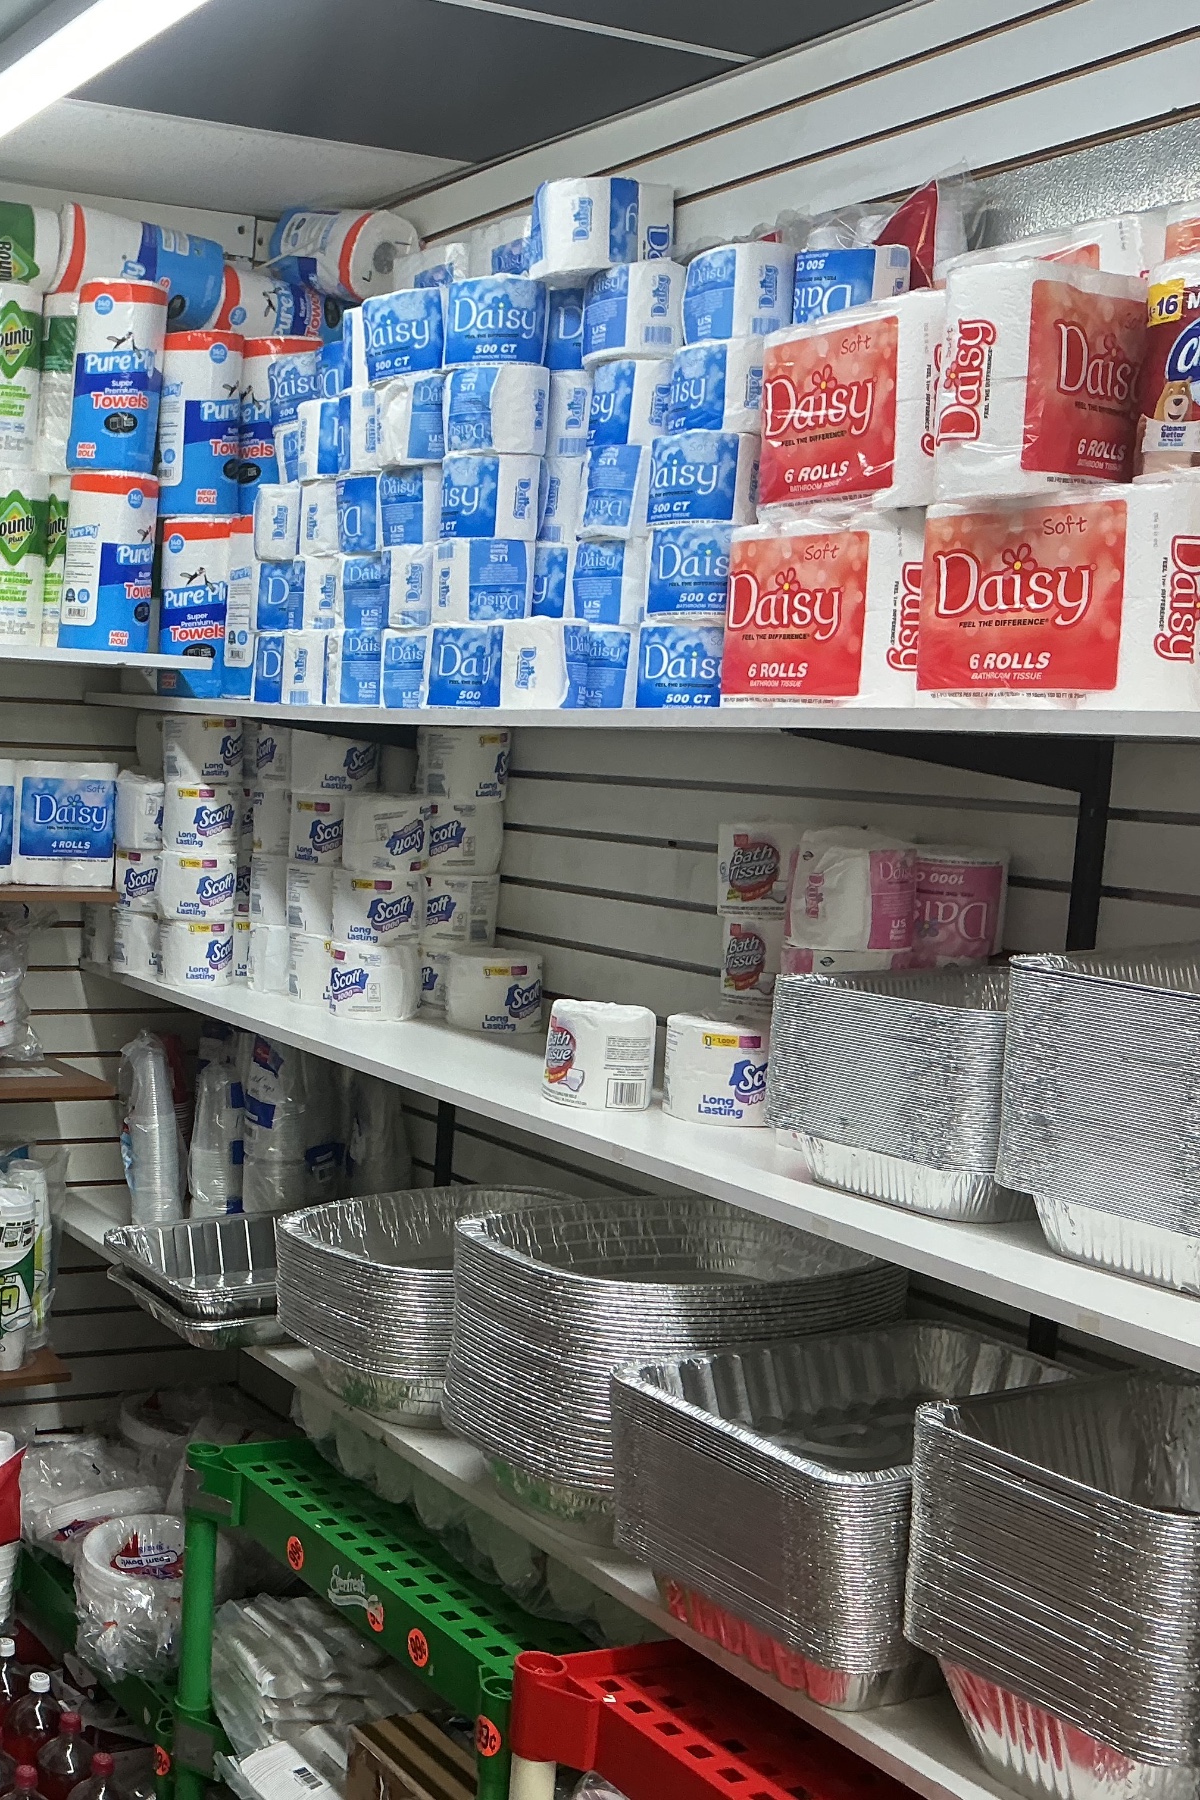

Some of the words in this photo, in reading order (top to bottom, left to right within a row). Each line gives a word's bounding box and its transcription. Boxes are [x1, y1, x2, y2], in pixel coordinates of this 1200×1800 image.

[572, 196, 593, 243] Daisy
[807, 259, 825, 270] 500
[651, 273, 672, 318] Daisy
[758, 264, 780, 310] Daisy
[1157, 294, 1178, 316] 16
[454, 297, 537, 340] Daisy
[475, 344, 498, 354] 500
[501, 344, 517, 354] CT
[840, 334, 871, 355] Soft
[85, 353, 131, 373] Pure
[375, 360, 392, 371] 500
[395, 356, 410, 368] CT
[111, 379, 134, 389] Super
[936, 318, 997, 447] Daisy
[91, 392, 148, 410] Towels
[565, 386, 588, 431] Daisy
[764, 374, 877, 440] Daisy
[77, 442, 96, 450] MEGA
[77, 449, 95, 458] ROLL
[1077, 440, 1087, 455] 6
[1087, 439, 1126, 462] ROLLS
[784, 469, 795, 484] 6
[797, 460, 849, 483] ROLLS
[196, 489, 217, 497] MEGA
[382, 479, 417, 496] Daisy
[196, 496, 216, 505] ROLL
[513, 477, 532, 521] Daisy
[652, 502, 671, 514] 500
[674, 501, 690, 512] CT
[271, 504, 289, 541] Daisy
[1043, 516, 1088, 536] Soft
[579, 549, 617, 569] Daisy
[804, 543, 840, 561] Soft
[406, 563, 424, 603] Daisy
[933, 549, 1094, 626] Daisy
[164, 590, 204, 609] Pure
[679, 592, 704, 603] 500
[707, 592, 725, 603] CT
[728, 570, 843, 642] Daisy
[1154, 534, 1199, 664] Daisy
[186, 613, 209, 621] Super
[958, 621, 976, 629] FEEL
[995, 618, 1049, 626] DIFFERENCE
[110, 631, 128, 639] MEGA
[170, 624, 225, 641] Towels
[110, 638, 128, 646] ROLL
[515, 646, 537, 690] Daisy
[969, 654, 980, 670] 6
[984, 652, 1050, 670] ROLLS
[747, 663, 757, 678] 6
[759, 662, 808, 679] ROLLS
[971, 671, 1011, 681] BATHROOM
[1012, 671, 1042, 681] TISSUE
[458, 690, 482, 700] 500
[665, 693, 690, 704] 500
[694, 693, 712, 704] CT
[201, 768, 229, 778] Lasting
[321, 781, 352, 791] Lasting
[33, 793, 108, 831] Daisy
[199, 804, 232, 828] Scott
[51, 841, 59, 849] 4
[60, 840, 91, 850] ROLLS
[175, 837, 203, 848] Lasting
[732, 844, 773, 865] Bath
[126, 867, 157, 890] Scott
[728, 861, 775, 882] Tissue
[199, 872, 235, 896] Scott
[176, 907, 206, 917] Lasting
[374, 895, 412, 922] Scott
[347, 932, 378, 943] Lasting
[728, 935, 760, 953] Bath
[185, 972, 215, 982] Lasting
[332, 968, 363, 989] Scott
[482, 1021, 516, 1032] Lasting
[484, 1014, 508, 1024] Long
[702, 1094, 735, 1108] Long
[698, 1104, 744, 1118] Lasting
